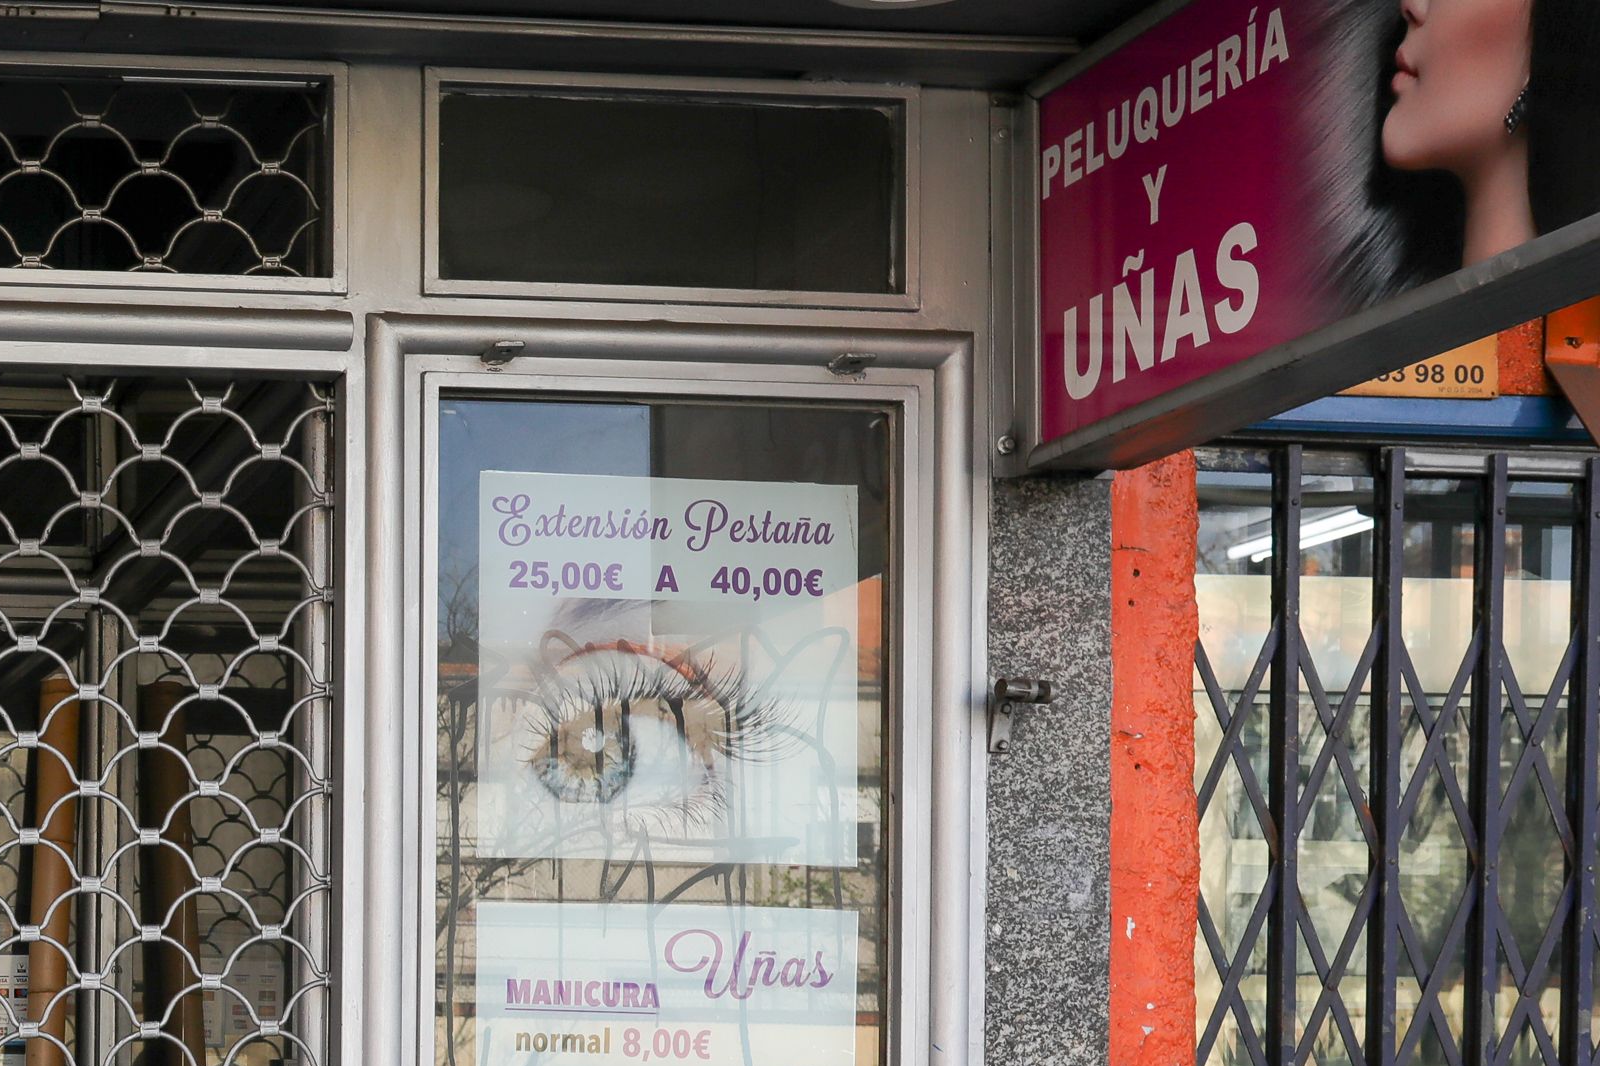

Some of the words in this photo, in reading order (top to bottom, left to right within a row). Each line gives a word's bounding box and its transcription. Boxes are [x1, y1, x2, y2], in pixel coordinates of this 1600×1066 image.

[1042, 5, 1289, 200] PELUQUERÍA
[1142, 164, 1167, 226] Y
[1063, 221, 1260, 401] UÑAS
[1414, 364, 1445, 384] 98
[1454, 364, 1485, 385] 00
[492, 493, 673, 547] Extensión
[684, 499, 835, 553] Pestaña
[508, 560, 624, 596] 25,00€
[654, 565, 679, 593] A
[710, 566, 824, 601] 40,00€
[506, 979, 660, 1009] MANICURA
[664, 929, 835, 1001] Uñas
[515, 1028, 610, 1055] normal
[622, 1028, 711, 1062] 8,00€
